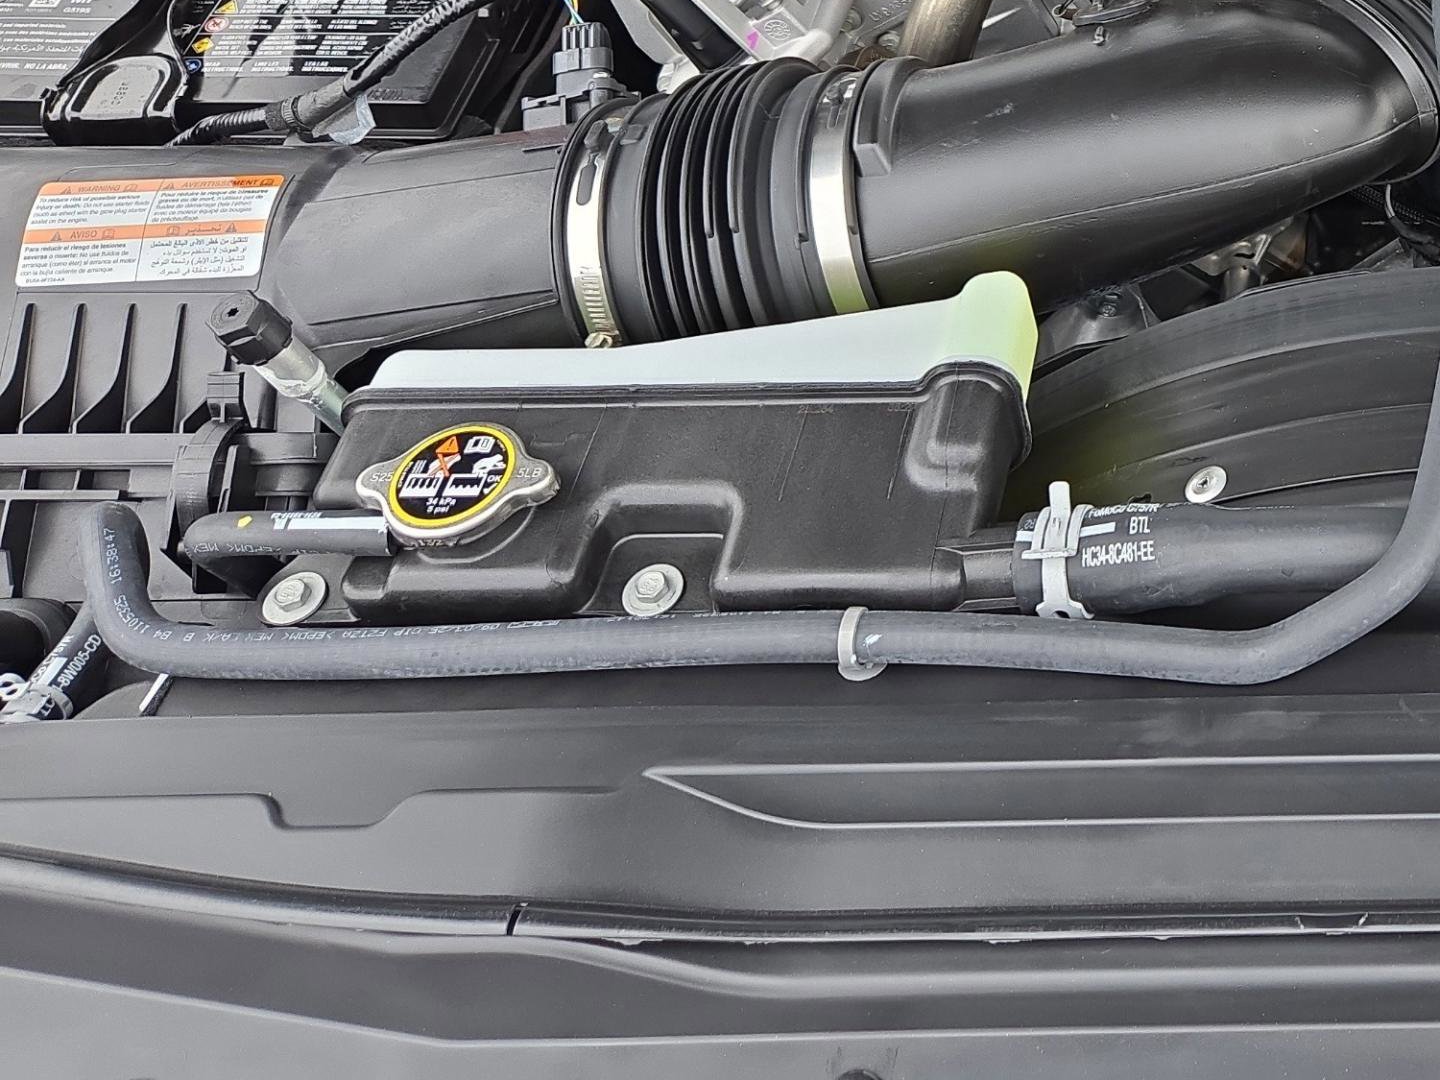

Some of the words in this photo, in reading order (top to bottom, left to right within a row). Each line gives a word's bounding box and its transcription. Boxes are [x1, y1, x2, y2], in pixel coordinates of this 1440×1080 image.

[70, 229, 98, 240] AVISO
[370, 472, 393, 482] S25
[517, 467, 543, 478] 5LB
[426, 498, 437, 506] 34
[439, 498, 456, 506] kPa
[433, 505, 449, 514] psi
[1129, 516, 1151, 535] BTL
[103, 527, 122, 584] 16:38:47
[1082, 540, 1156, 568] HC34-8C481-EE
